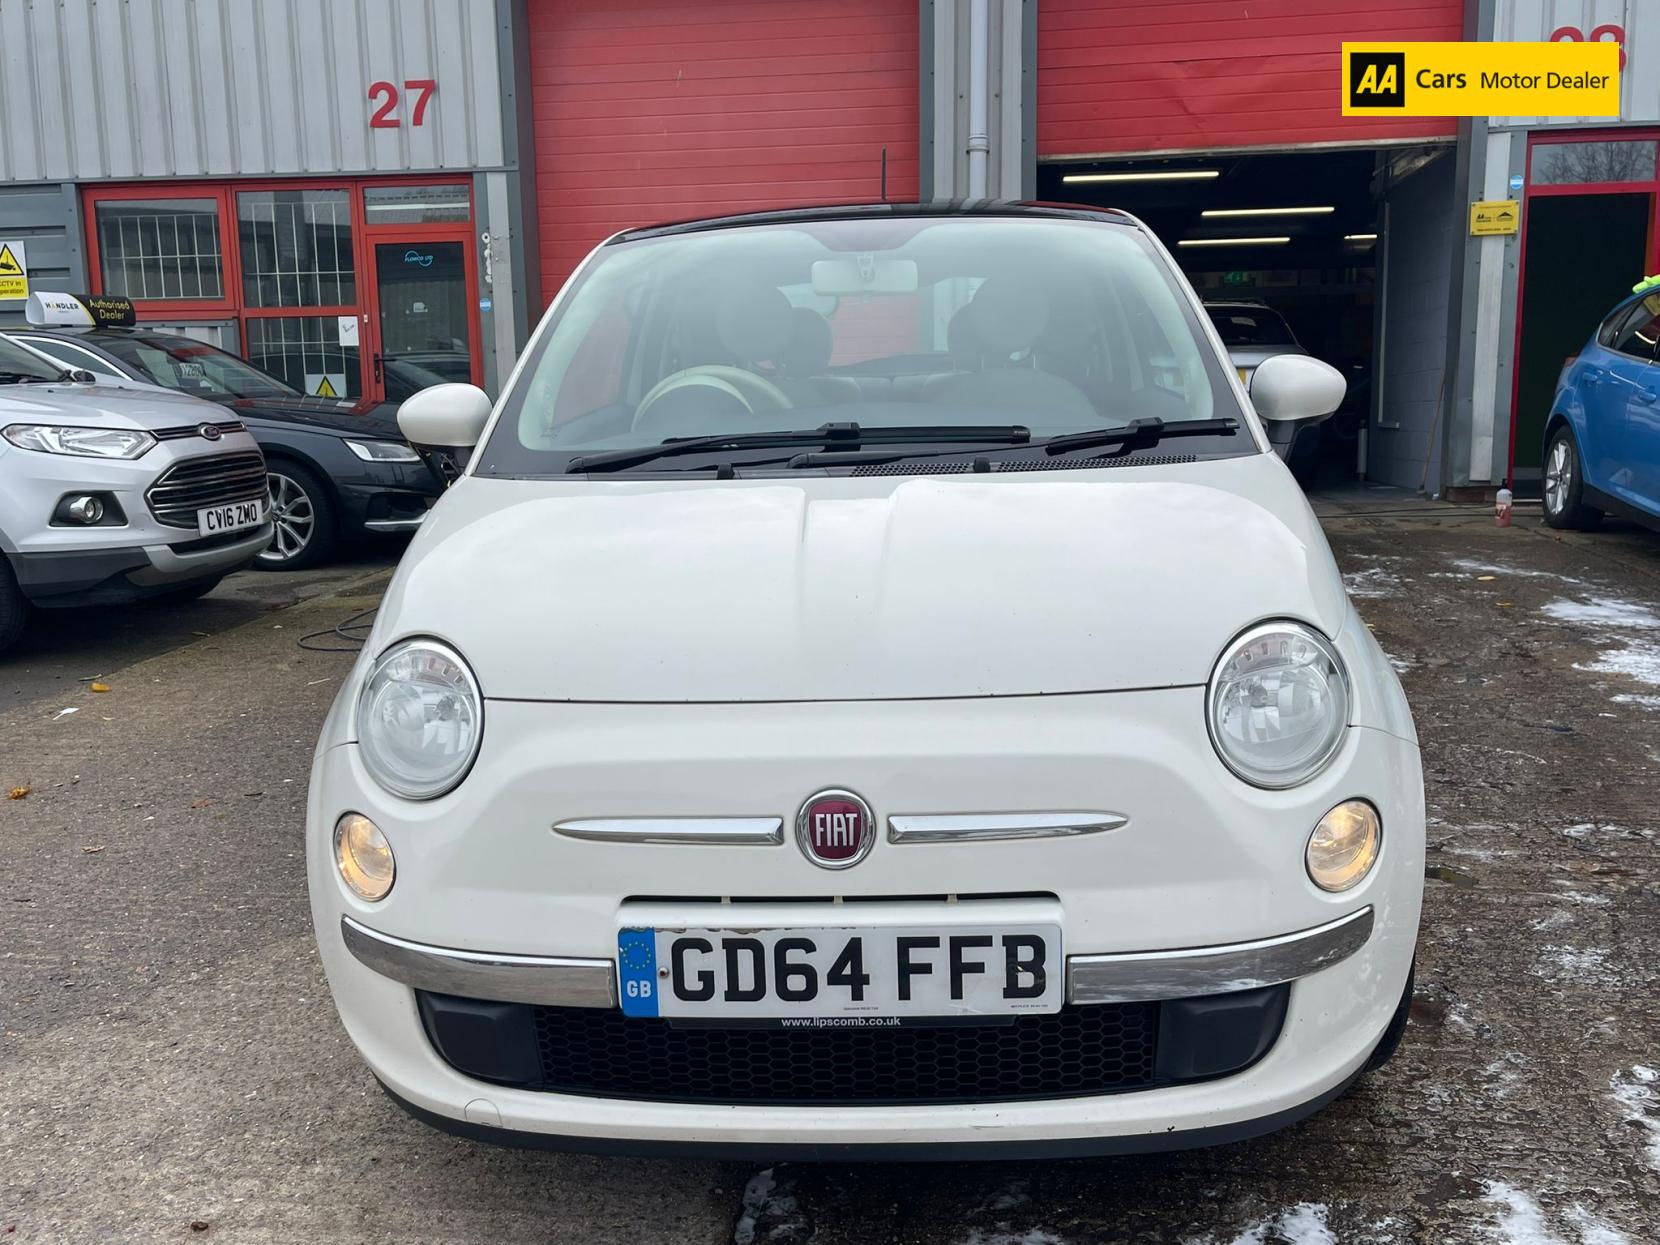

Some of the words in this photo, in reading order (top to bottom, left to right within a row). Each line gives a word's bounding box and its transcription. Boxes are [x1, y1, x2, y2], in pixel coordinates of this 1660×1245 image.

[368, 80, 435, 128] 27
[89, 299, 130, 310] Authorised
[100, 309, 125, 320] Dealer
[206, 508, 234, 530] CV16
[236, 503, 257, 525] ZMO
[815, 813, 858, 847] FIAT
[671, 936, 870, 1002] GD64
[896, 934, 1046, 1000] FFB
[626, 980, 652, 998] GB
[781, 1016, 901, 1028] www.lipscomb.co.uk
